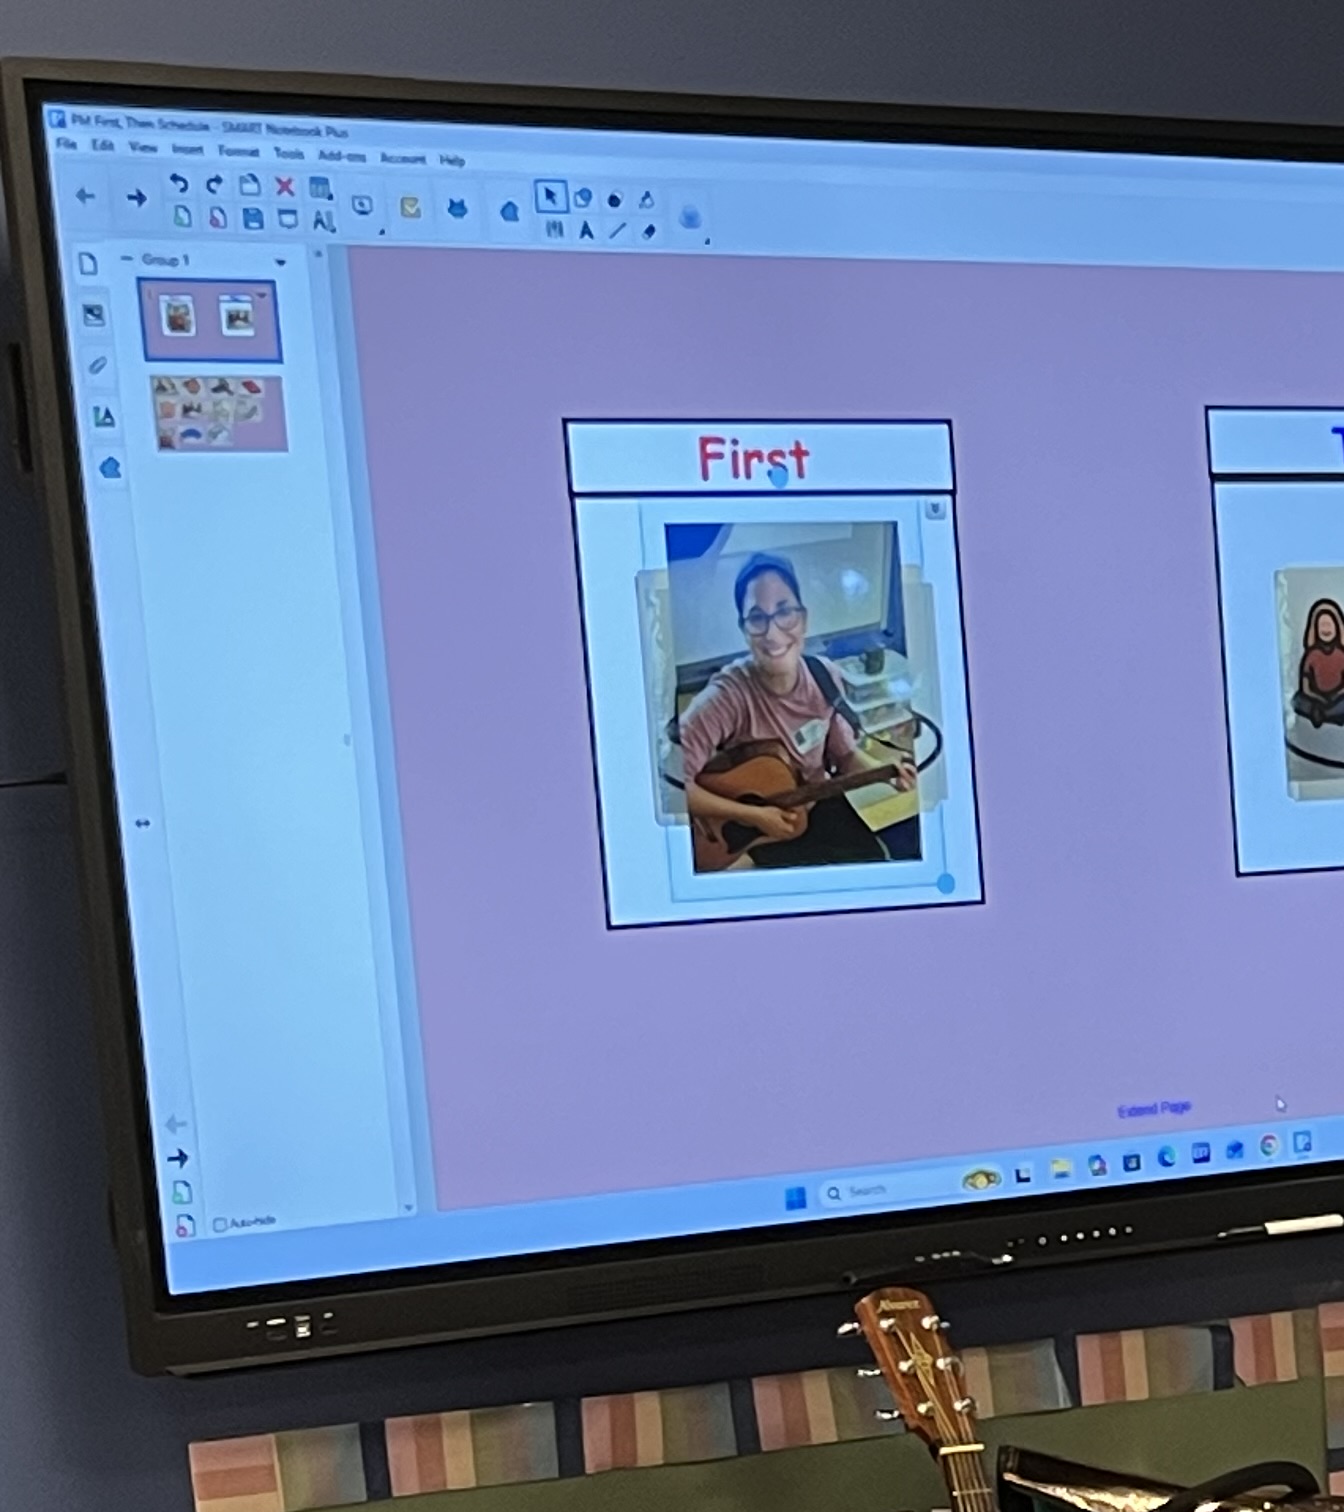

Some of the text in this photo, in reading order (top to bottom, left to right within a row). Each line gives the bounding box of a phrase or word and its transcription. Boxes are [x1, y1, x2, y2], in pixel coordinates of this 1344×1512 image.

[56, 137, 77, 151] File
[91, 137, 115, 152] Edit
[129, 141, 158, 154] View
[439, 154, 466, 168] Help
[141, 252, 180, 268] Group
[697, 434, 811, 483] First
[1116, 1101, 1192, 1119] Extend Page
